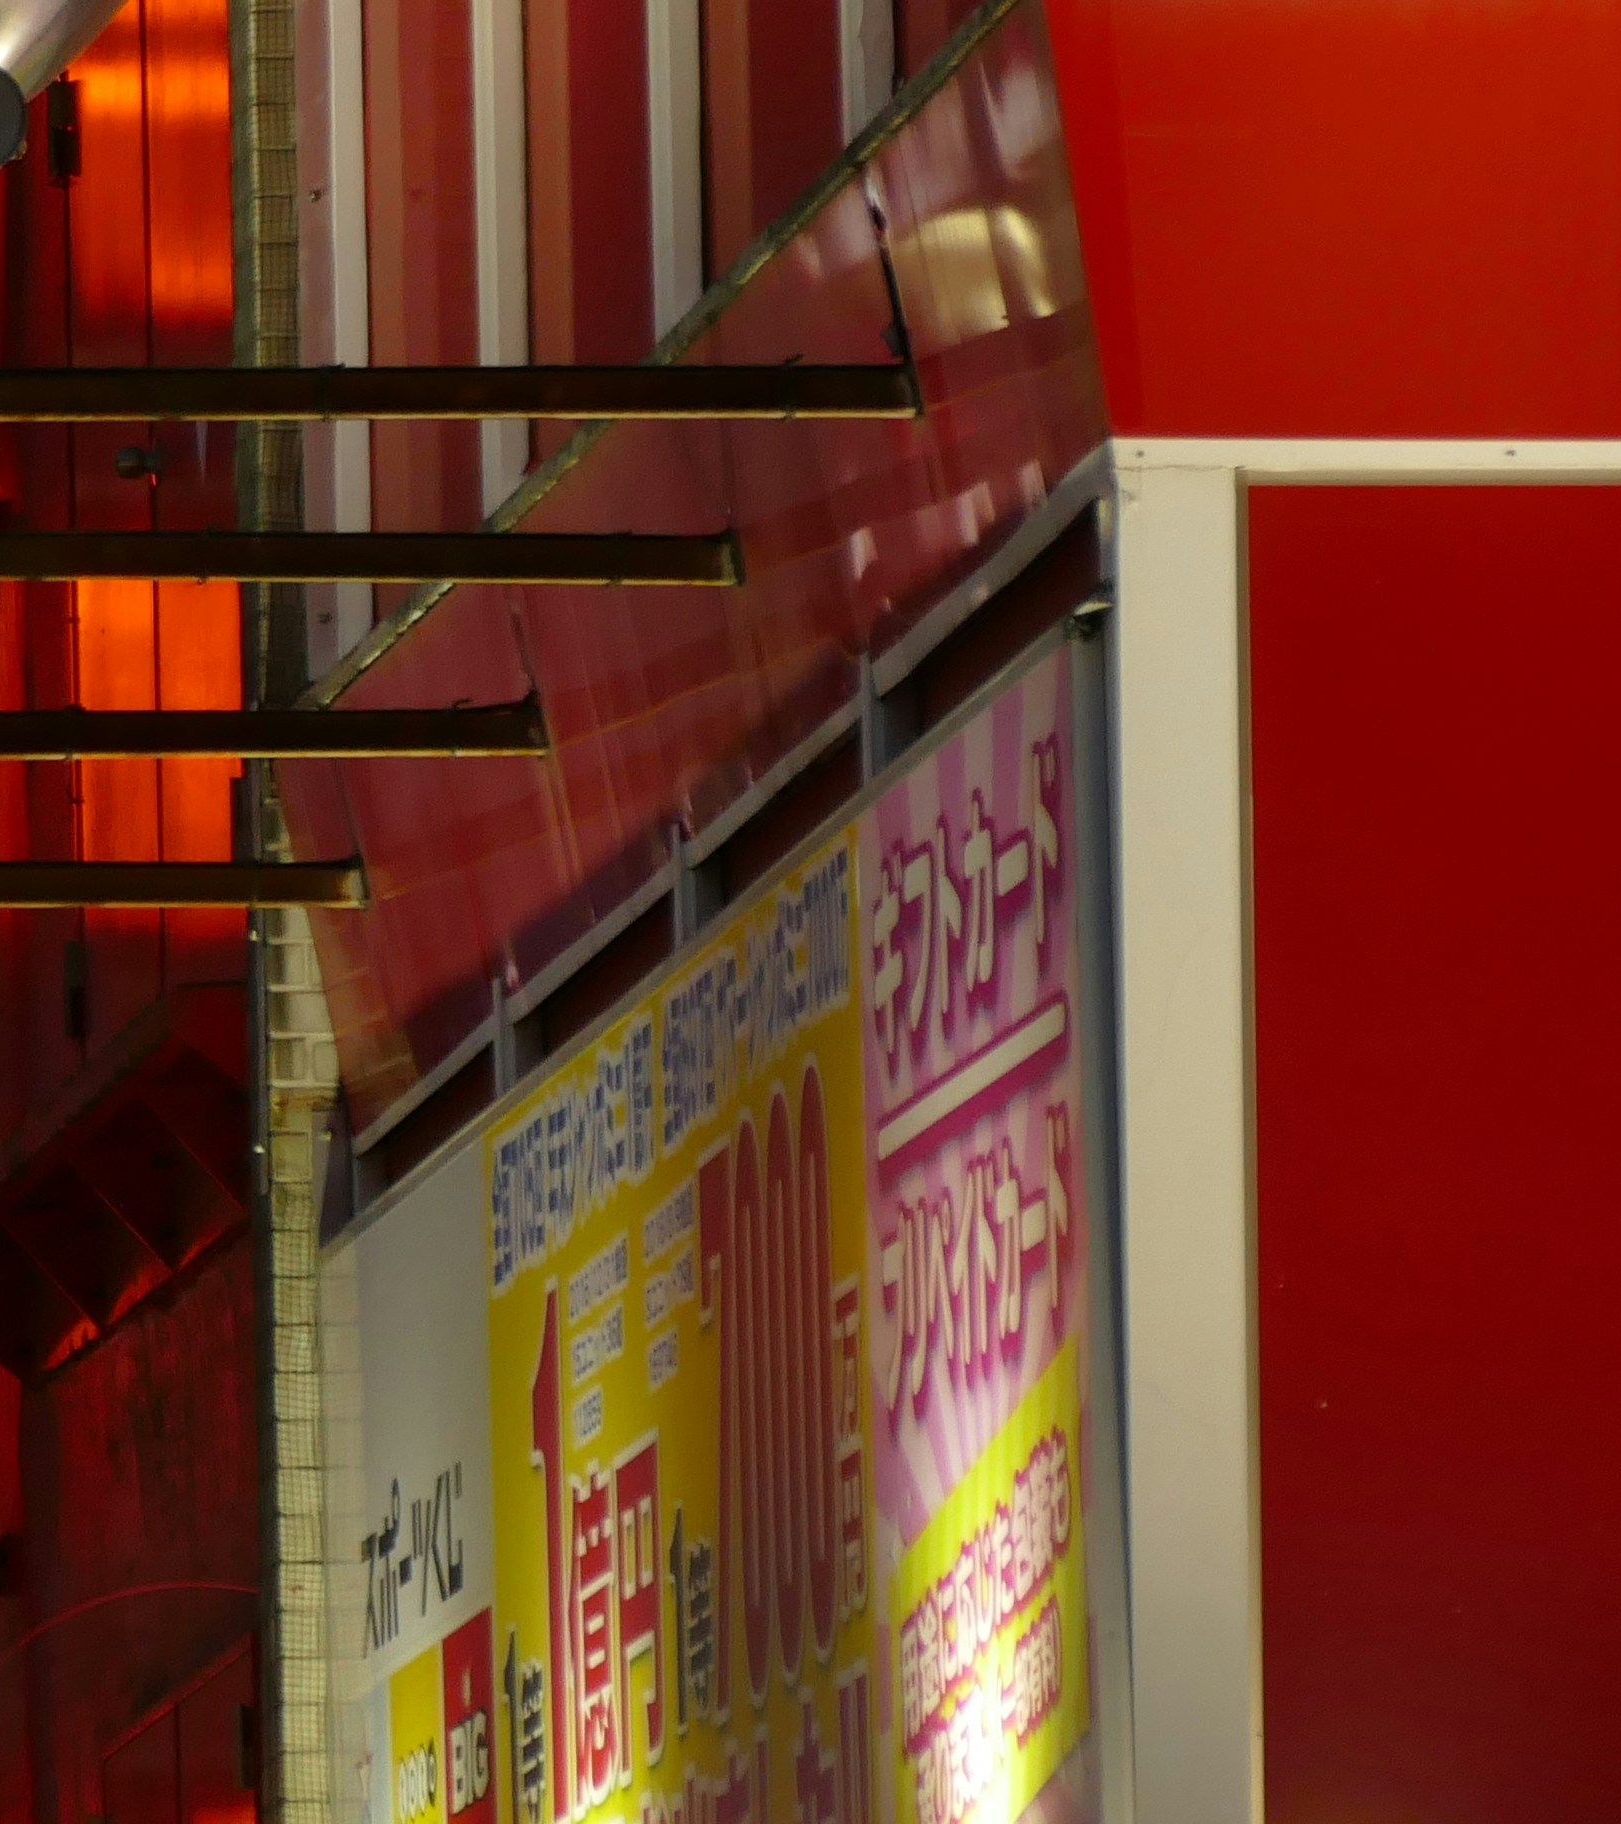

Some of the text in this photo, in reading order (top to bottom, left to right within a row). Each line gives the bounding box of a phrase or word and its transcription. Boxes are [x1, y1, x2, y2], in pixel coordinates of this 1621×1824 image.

[873, 736, 1061, 1061] ギフトカード
[882, 1102, 1069, 1414] プリペイドカード
[362, 1461, 464, 1659] スポーツくじ
[450, 1708, 492, 1816] BIG
